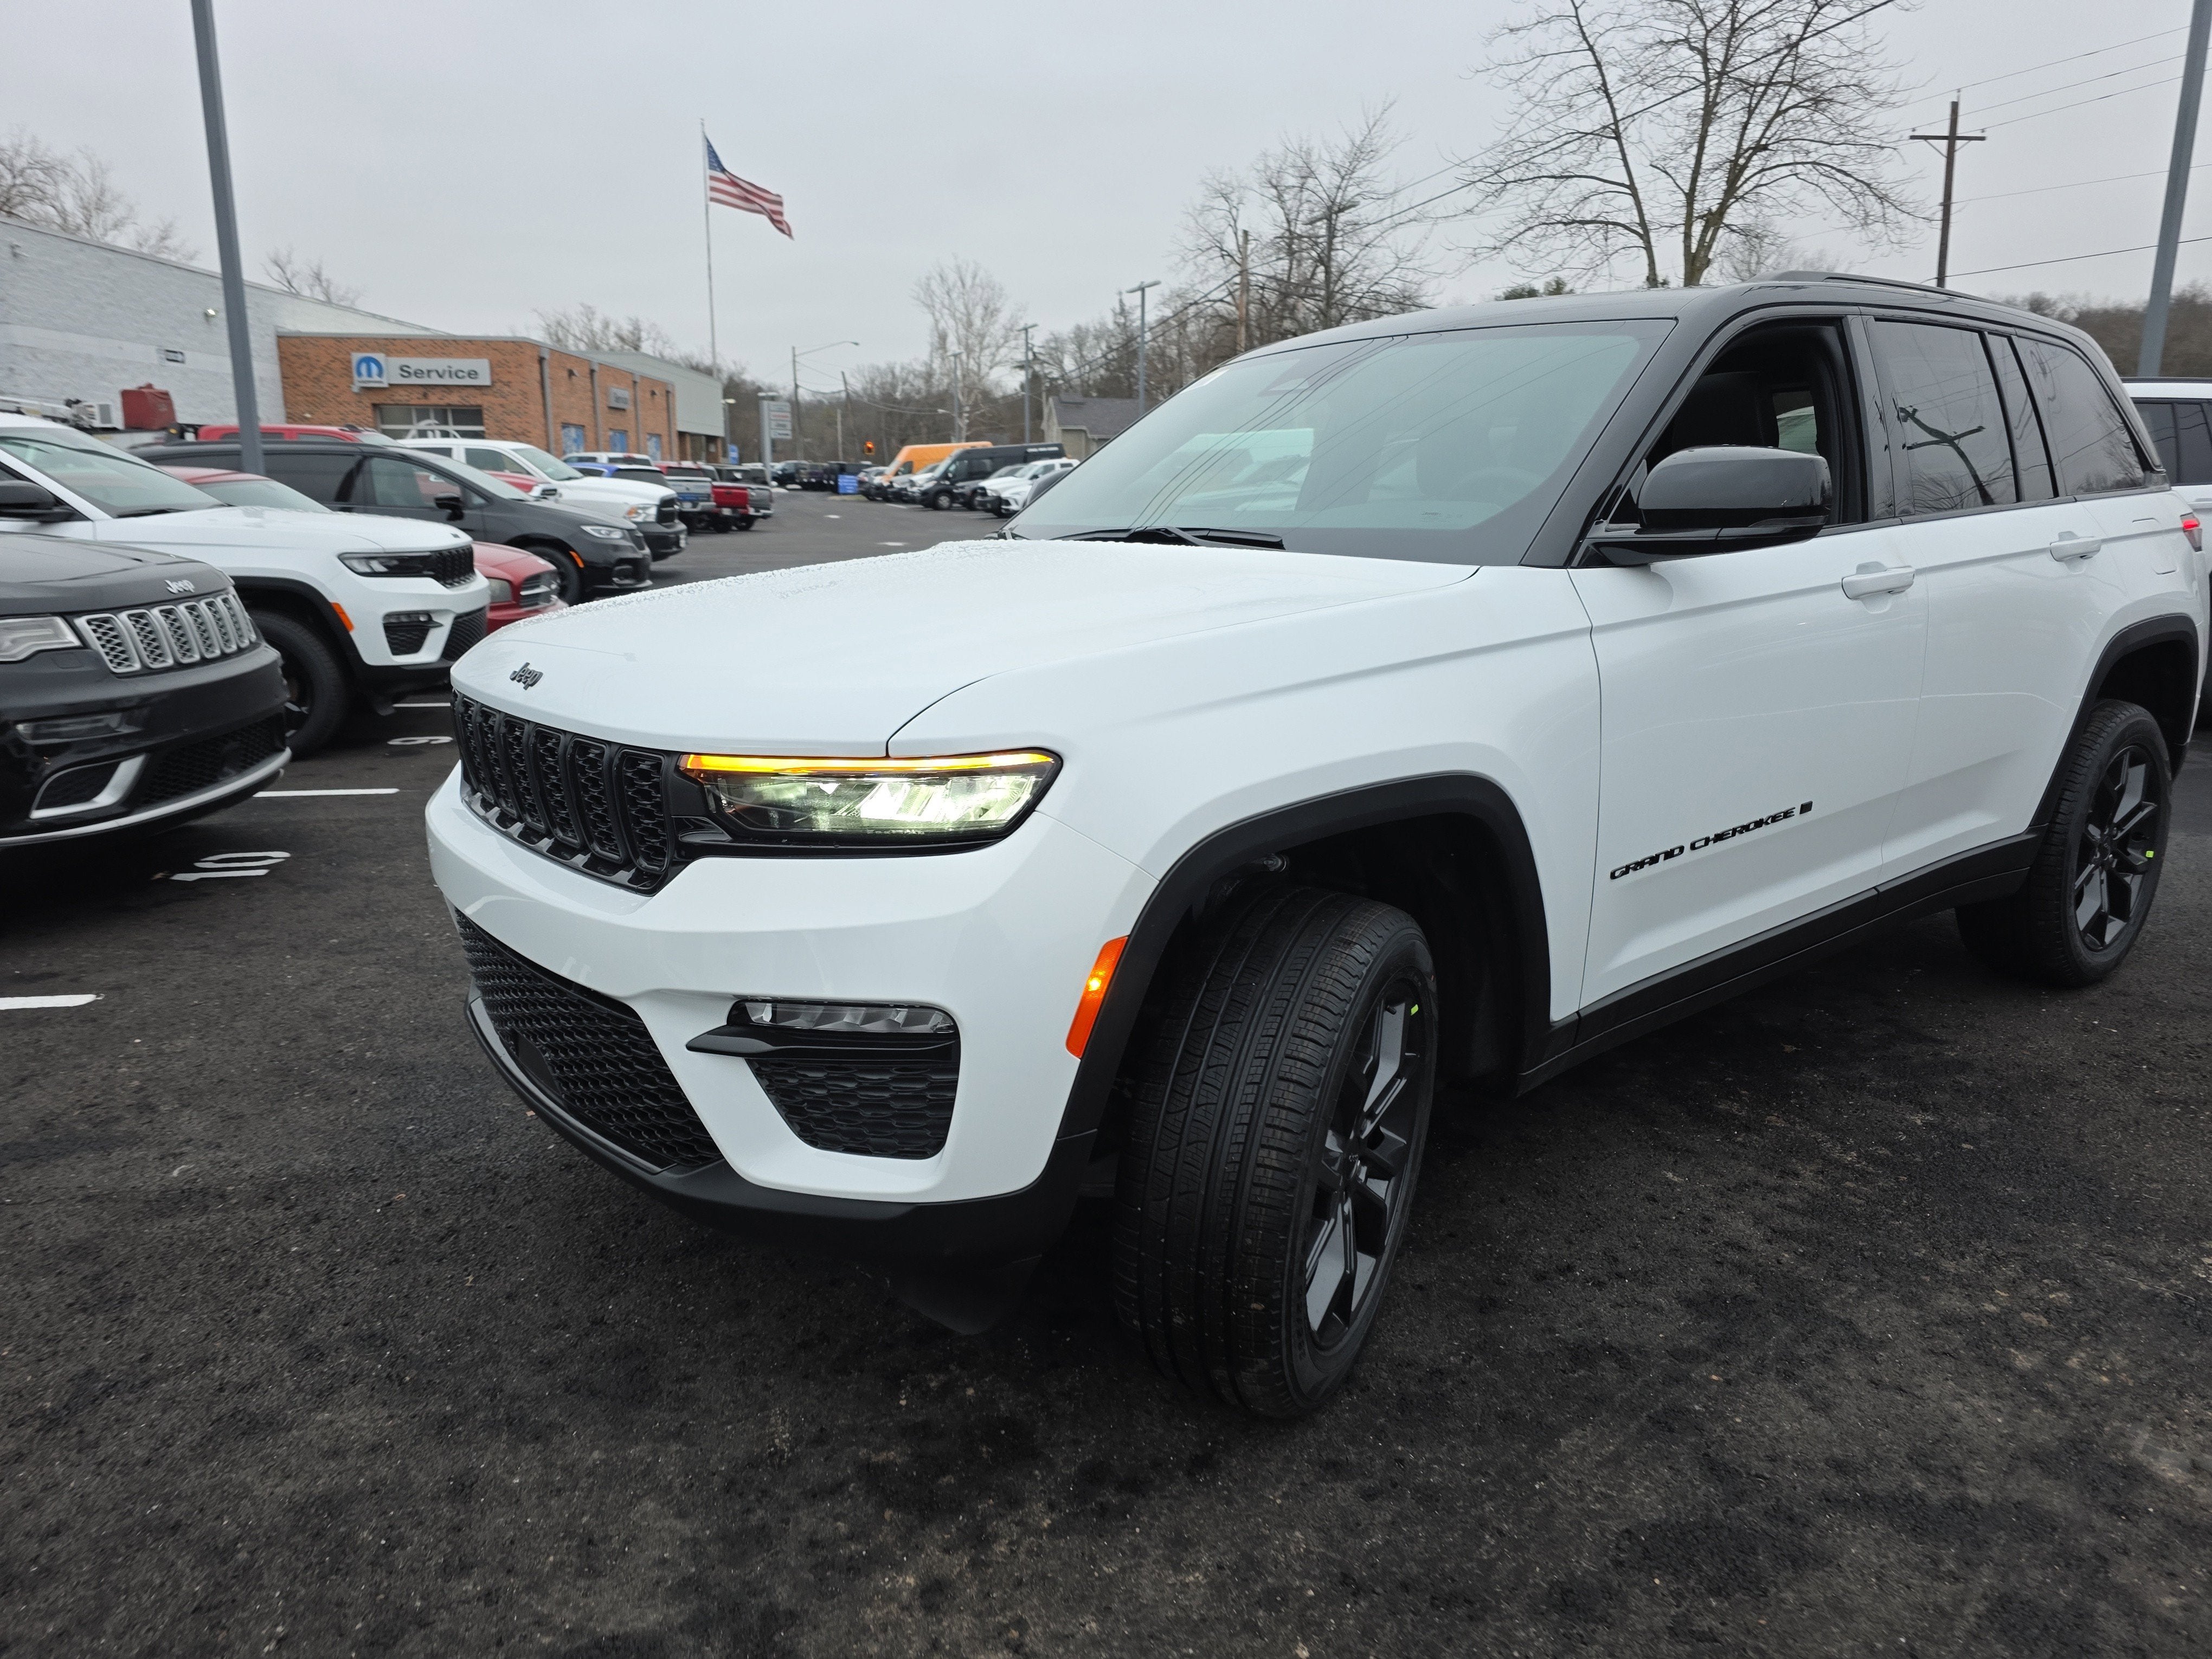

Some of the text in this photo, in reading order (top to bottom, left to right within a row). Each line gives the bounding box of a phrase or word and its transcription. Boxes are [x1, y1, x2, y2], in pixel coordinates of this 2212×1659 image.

[399, 364, 479, 380] Service
[164, 580, 195, 594] Jeep
[510, 662, 543, 691] Jeep
[1610, 807, 1796, 880] GRAND CHEROKEE
[169, 851, 291, 881] 10
